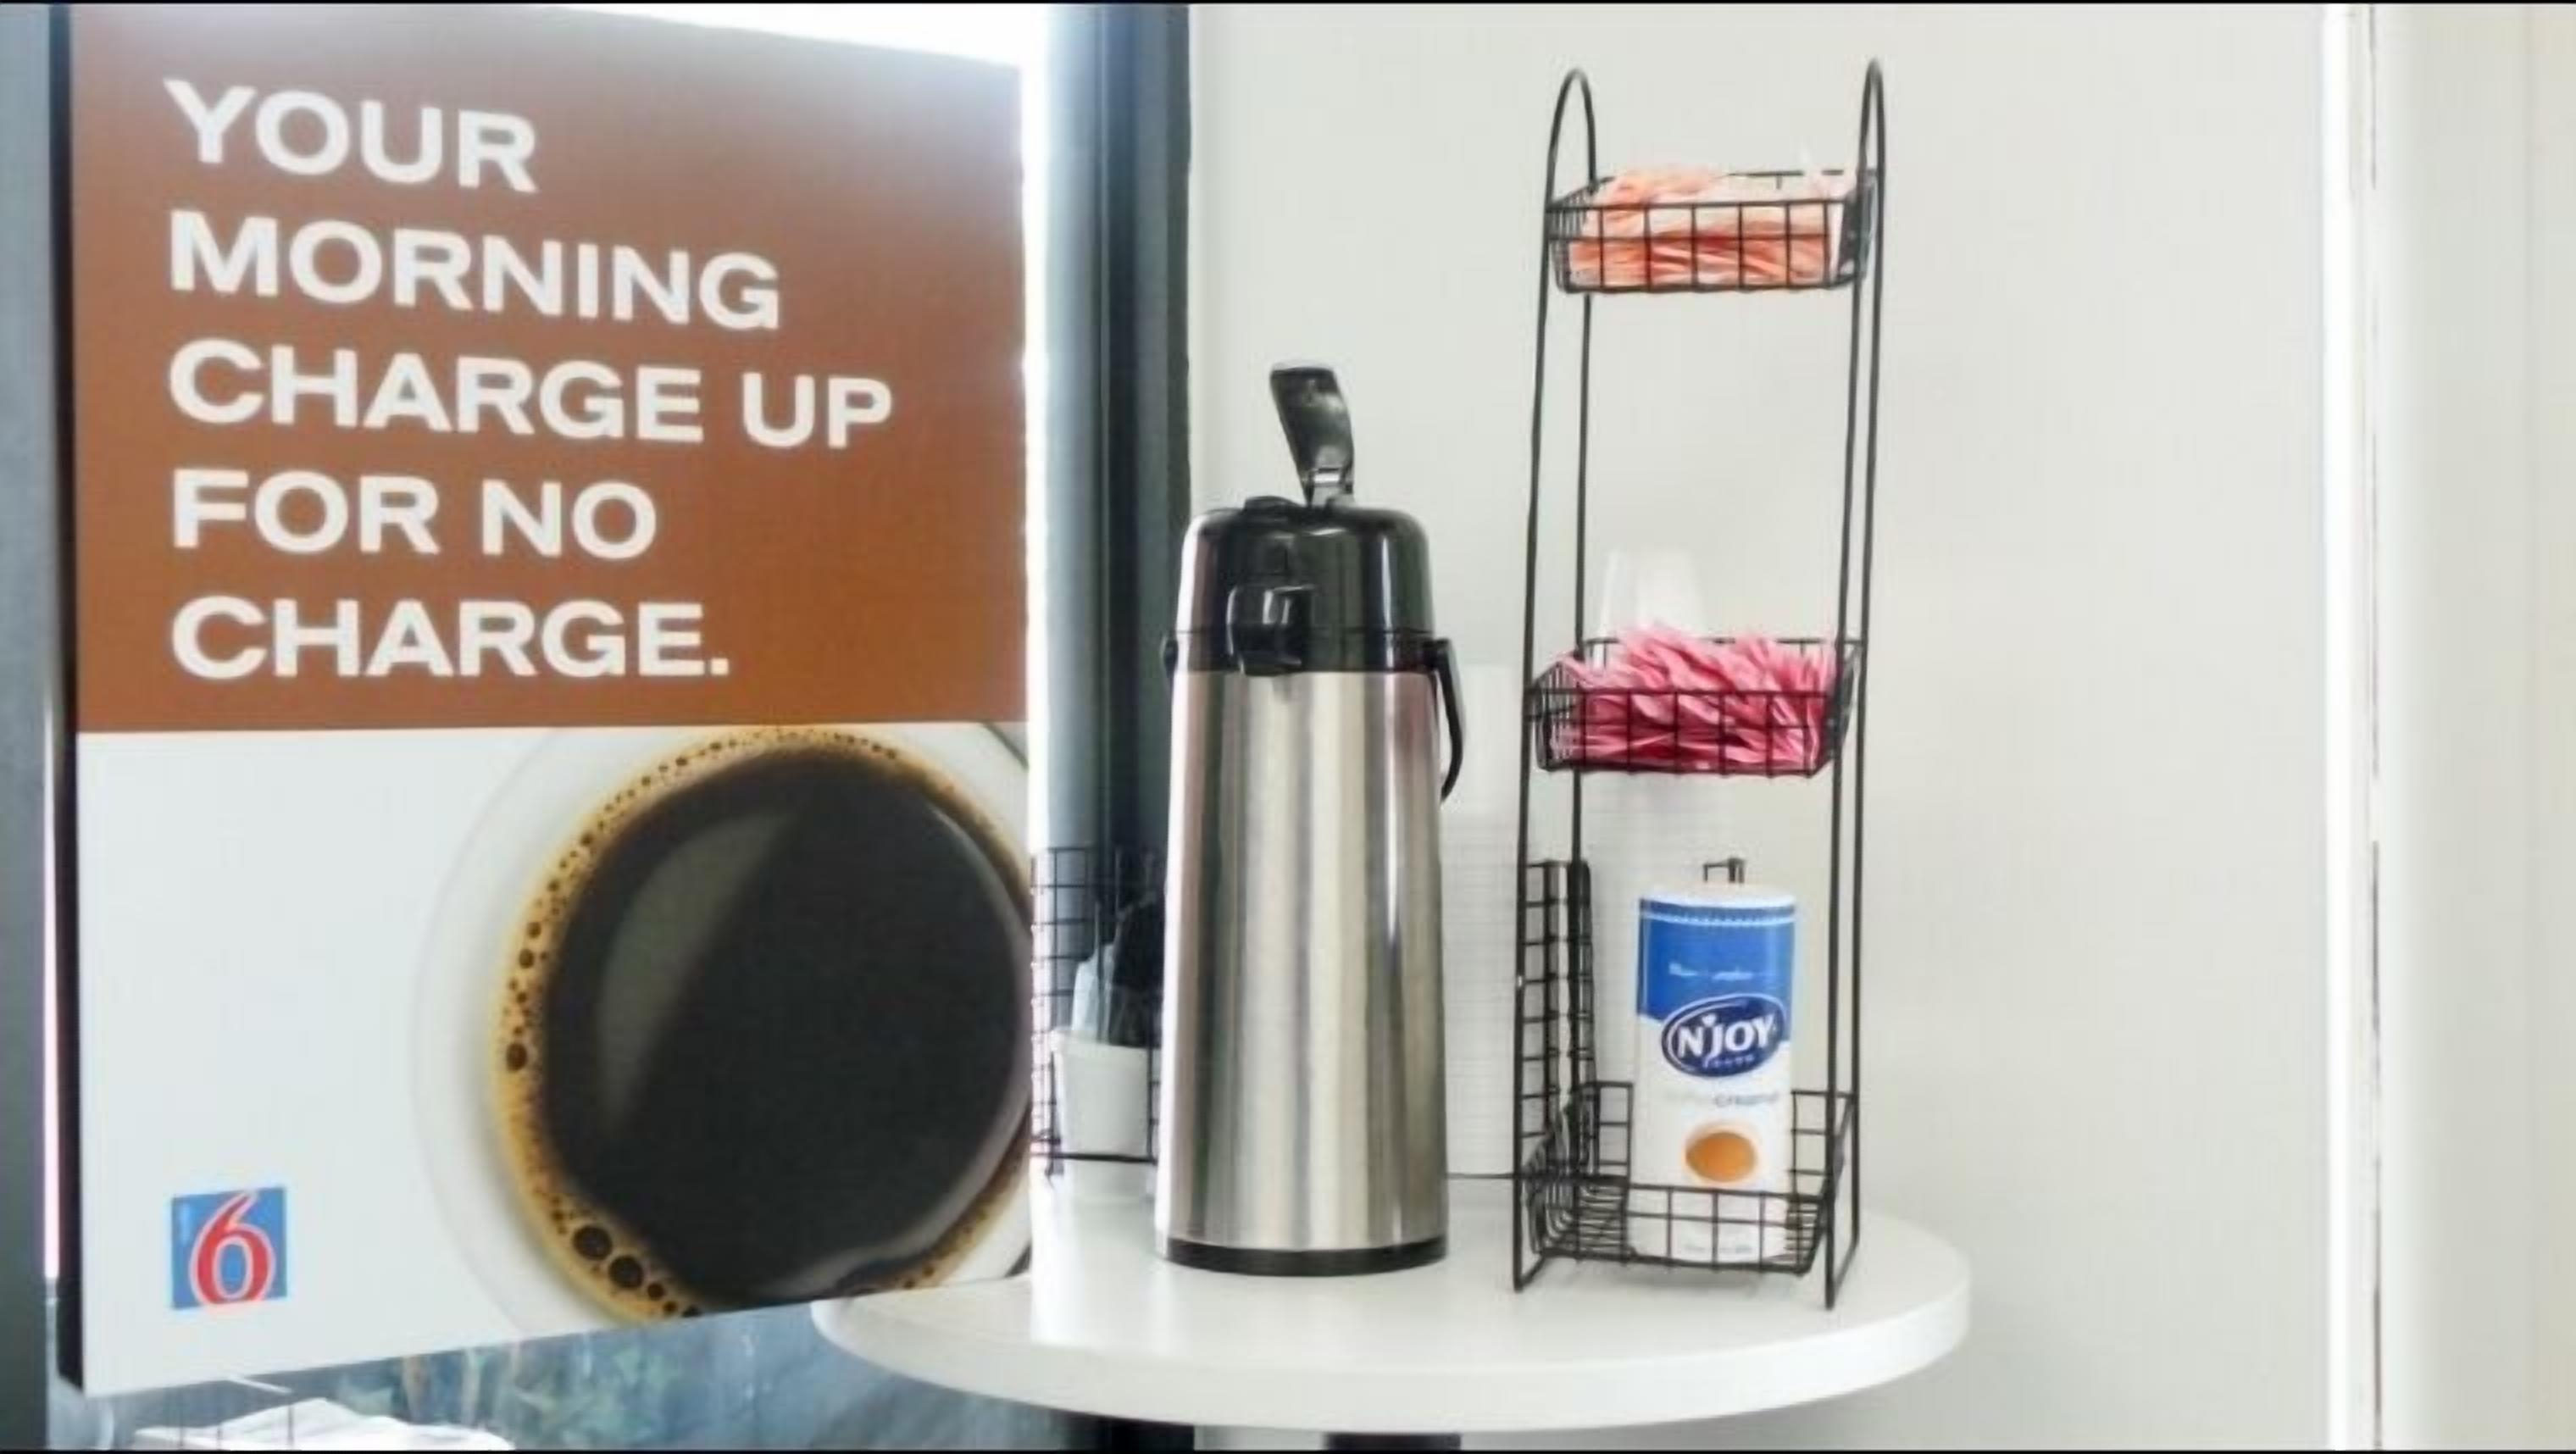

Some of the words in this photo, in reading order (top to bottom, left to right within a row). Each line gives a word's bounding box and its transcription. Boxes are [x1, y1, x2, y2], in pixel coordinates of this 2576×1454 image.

[164, 78, 538, 193] YOUR
[169, 209, 781, 330] MORNING
[168, 337, 704, 443] CHARGE
[742, 371, 893, 449] UP
[172, 467, 441, 555] FOR
[480, 478, 657, 561] NO
[170, 595, 730, 680] CHARGE.
[188, 1190, 277, 1306] 6
